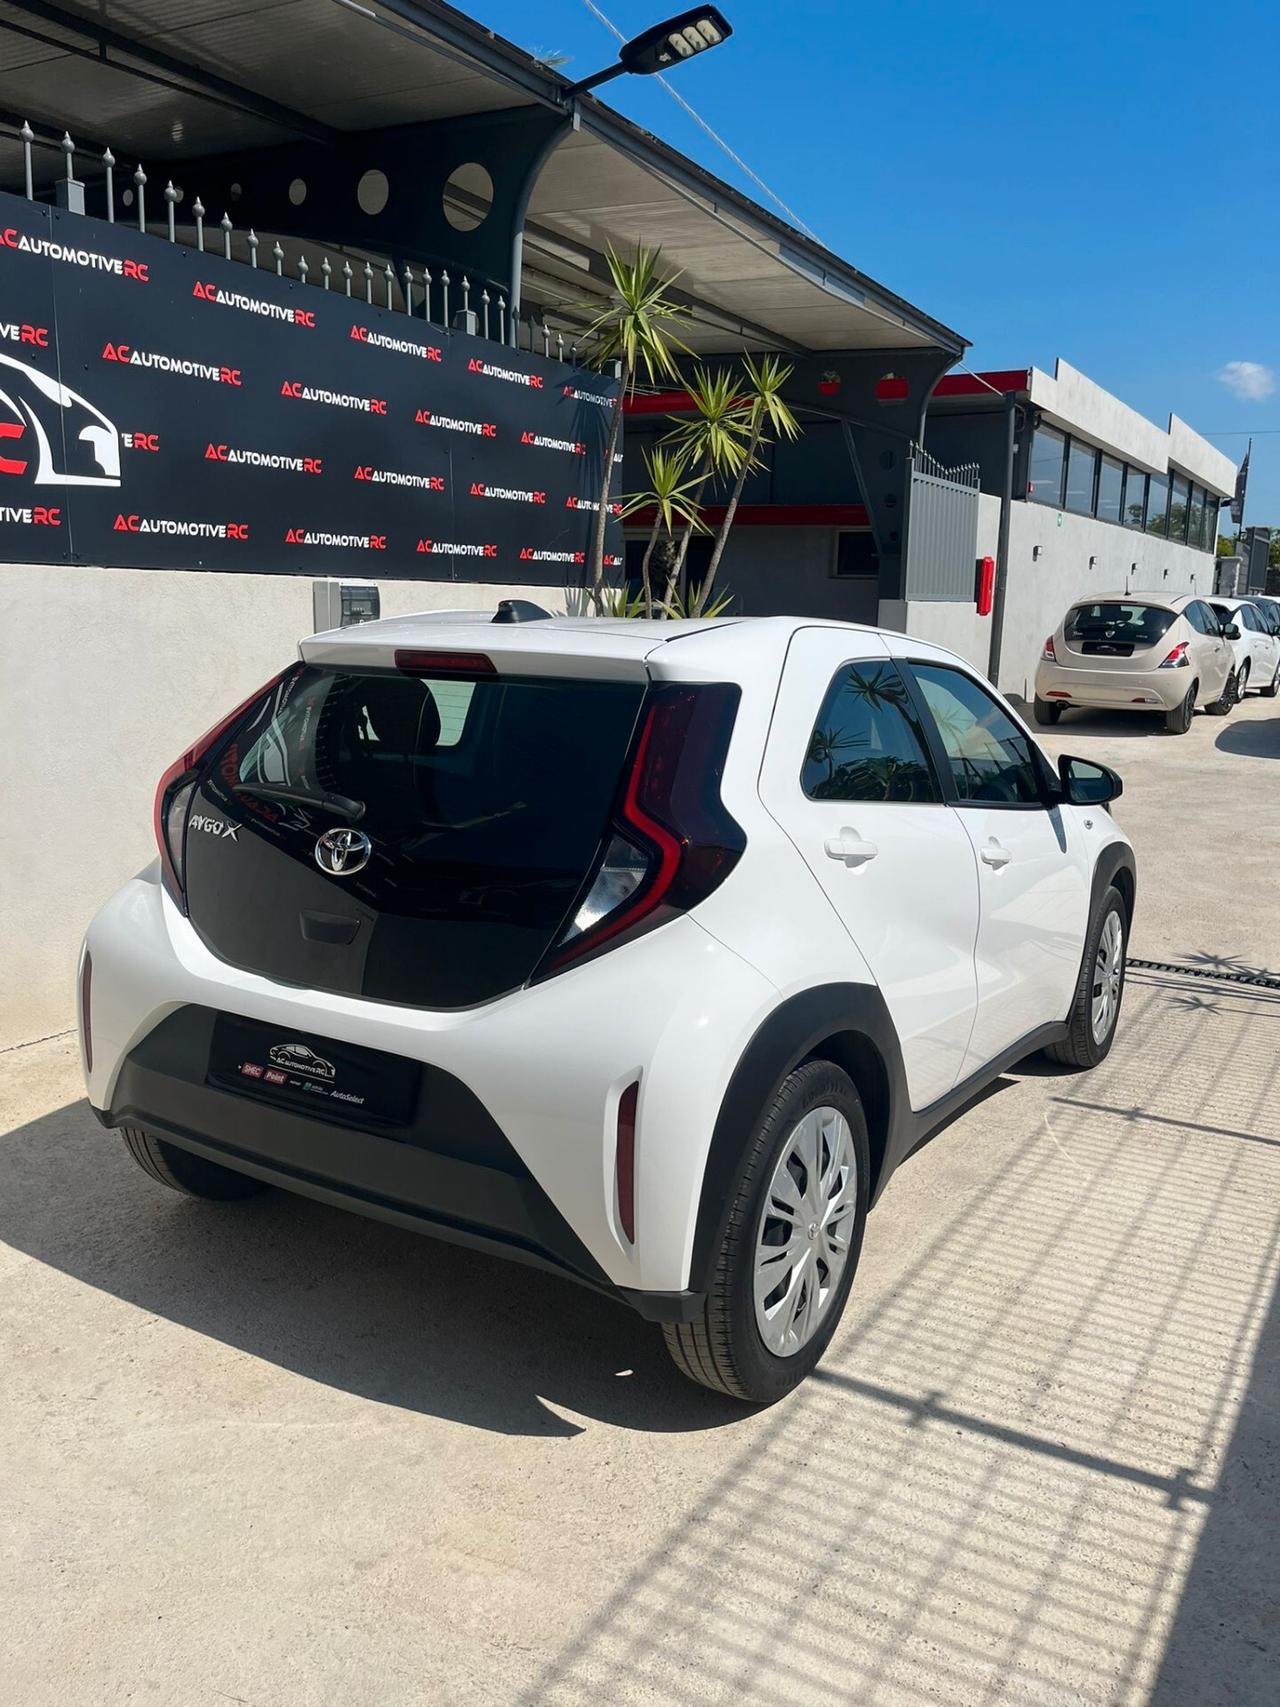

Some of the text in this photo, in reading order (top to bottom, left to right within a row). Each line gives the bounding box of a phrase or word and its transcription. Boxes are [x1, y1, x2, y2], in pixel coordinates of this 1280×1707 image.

[192, 281, 315, 327] ACAUTOMOTIVERC
[351, 325, 442, 362] ACAUTOMOTIVERC
[102, 342, 241, 386] ACAUTOMOTIVERC
[468, 358, 544, 388] ACAUTOMOTIVERC
[281, 381, 387, 415] ACAUTOMOTIVERC
[415, 410, 497, 437] ACAUTOMOTIVERC
[205, 443, 322, 473] ACAUTOMOTIVERC
[354, 466, 444, 490] ACAUTOMOTIVERC
[470, 483, 546, 504] ACAUTOMOTIVERC
[113, 514, 248, 540] ACAUTOMOTIVERC
[285, 529, 387, 550] ACAUTOMOTIVERC
[416, 539, 497, 557] ACAUTOMOTIVERC
[519, 548, 585, 563] ACAUTOMOTIVERC
[189, 814, 224, 835] AYGO
[222, 823, 243, 841] X
